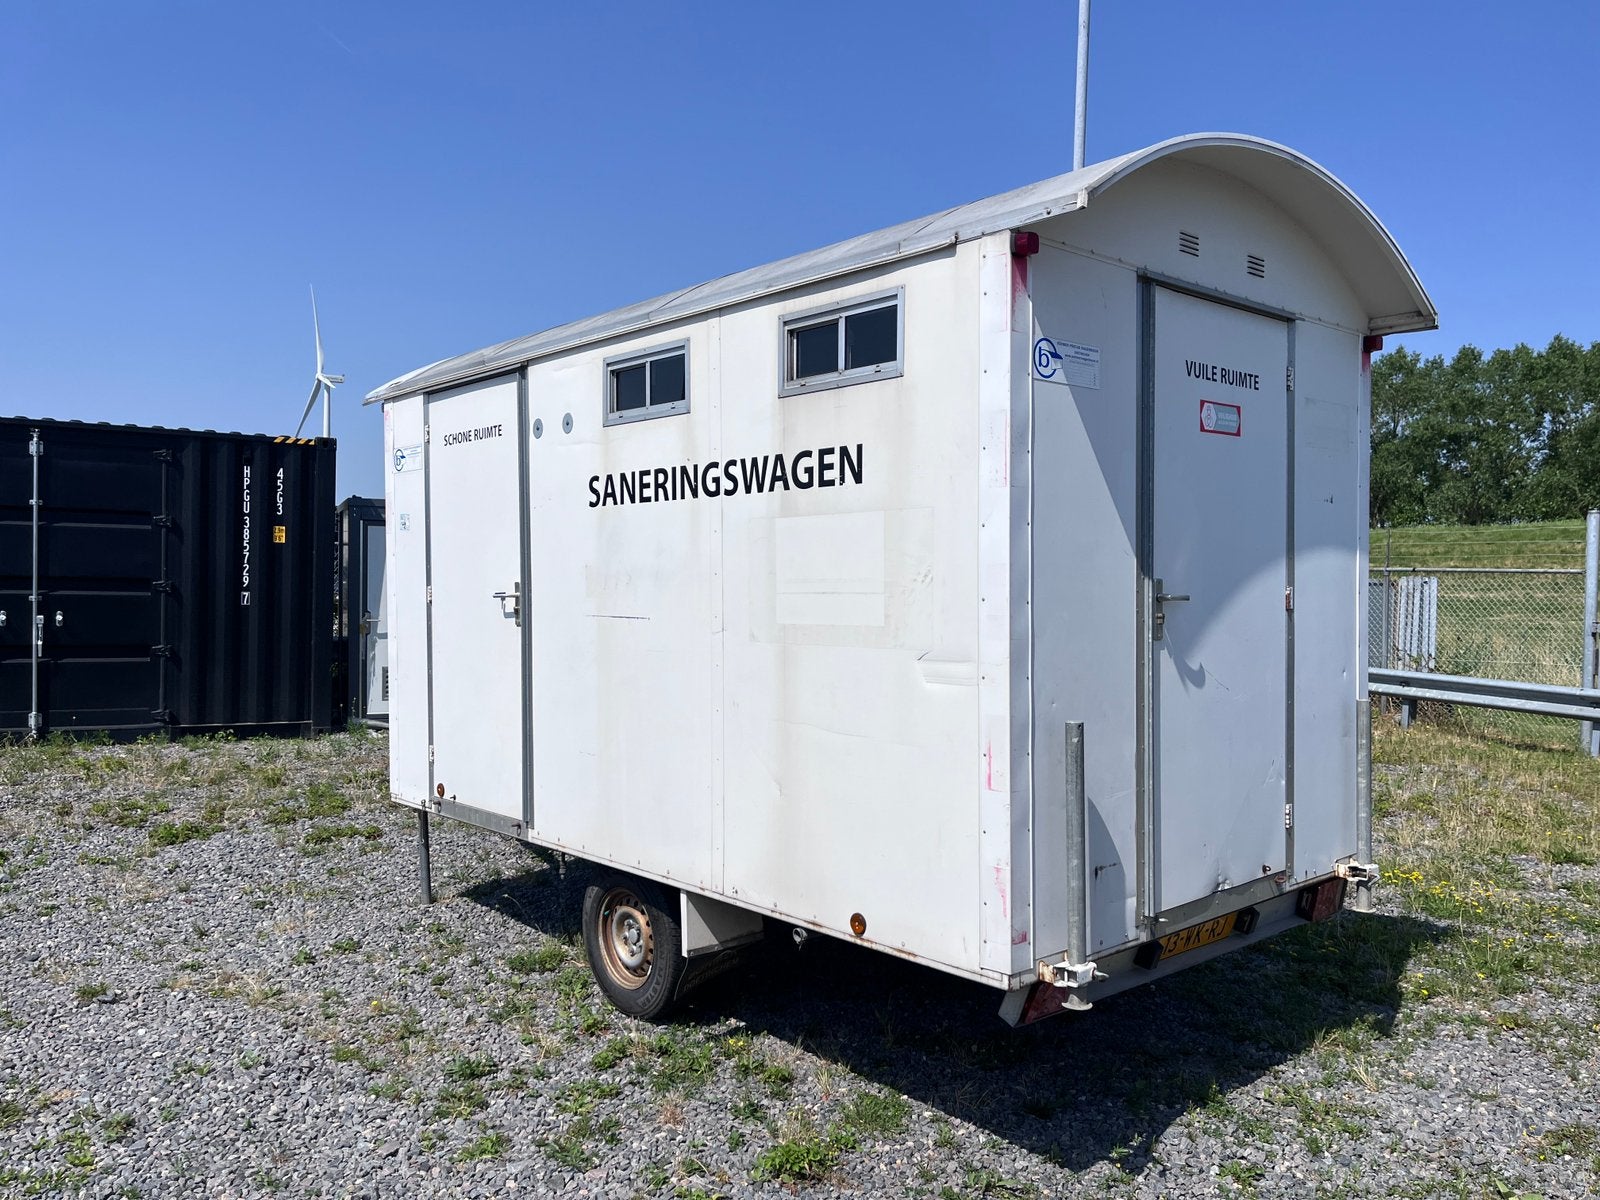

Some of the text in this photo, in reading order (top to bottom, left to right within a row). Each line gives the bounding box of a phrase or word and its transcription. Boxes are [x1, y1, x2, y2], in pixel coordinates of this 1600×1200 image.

[1185, 359, 1260, 391] VUILE RUIMTE
[443, 423, 503, 446] SCHONE RUIMTE
[276, 467, 284, 516] 45G3
[588, 443, 864, 508] SANERINGSWAGEN
[242, 465, 251, 606] HPGU 385729 7
[1162, 916, 1230, 956] 13-WK-RJ
